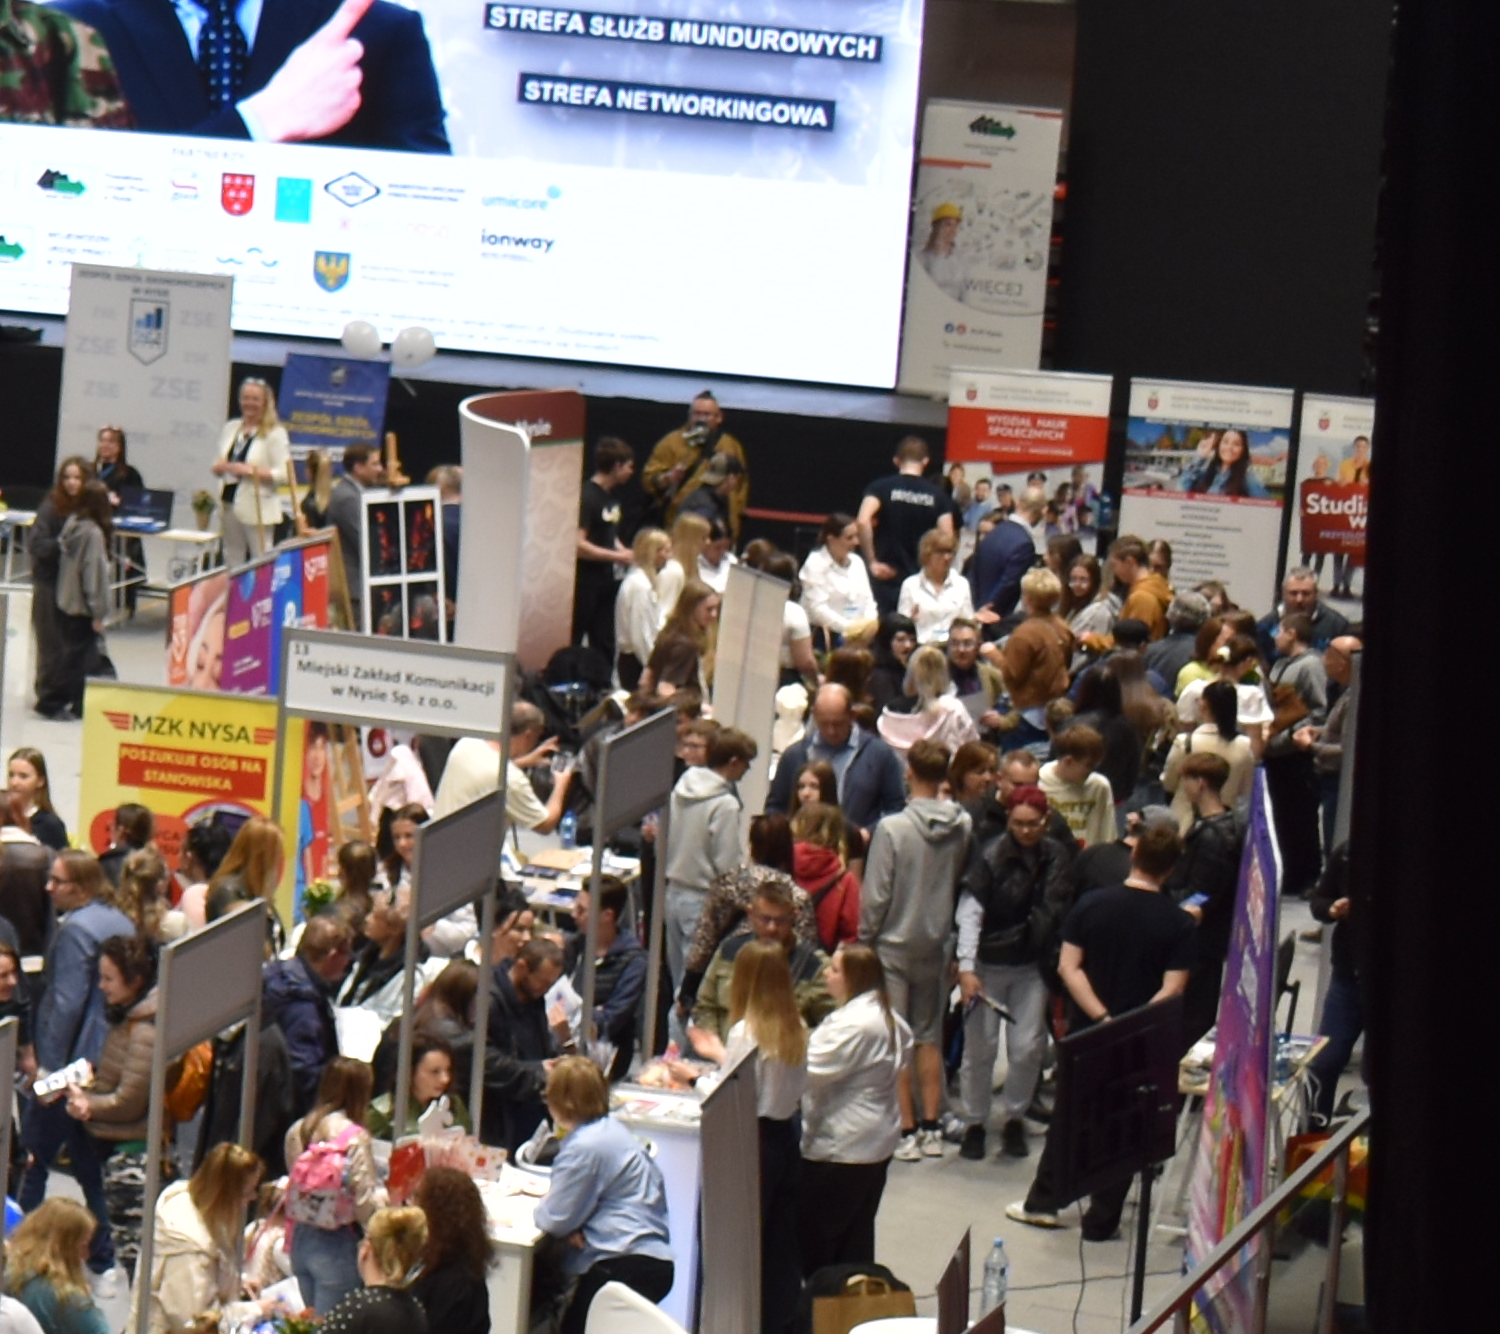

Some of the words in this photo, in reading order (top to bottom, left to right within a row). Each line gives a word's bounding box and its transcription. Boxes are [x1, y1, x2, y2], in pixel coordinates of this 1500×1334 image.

[489, 6, 585, 35] STREFA
[589, 11, 664, 42] SŁUŻB
[669, 22, 876, 60] MUNDUROWYCH
[524, 80, 612, 108] STREFA
[615, 87, 828, 129] NETWORKINGOWA
[482, 194, 549, 212] umicore
[481, 229, 555, 254] ionway
[1306, 493, 1367, 516] Studi
[295, 644, 310, 656] 13
[297, 658, 348, 684] Miejski
[352, 665, 401, 685] Zakład
[404, 670, 495, 696] Komunikacji
[348, 683, 382, 706] Nysie
[385, 688, 414, 709] Sp.
[132, 713, 184, 738] MZK
[189, 718, 252, 745] NYSA
[120, 747, 194, 767] POSZUKUJE
[197, 754, 238, 772] OSÓB
[241, 760, 262, 774] NA
[143, 771, 233, 792] STANOWISKA
